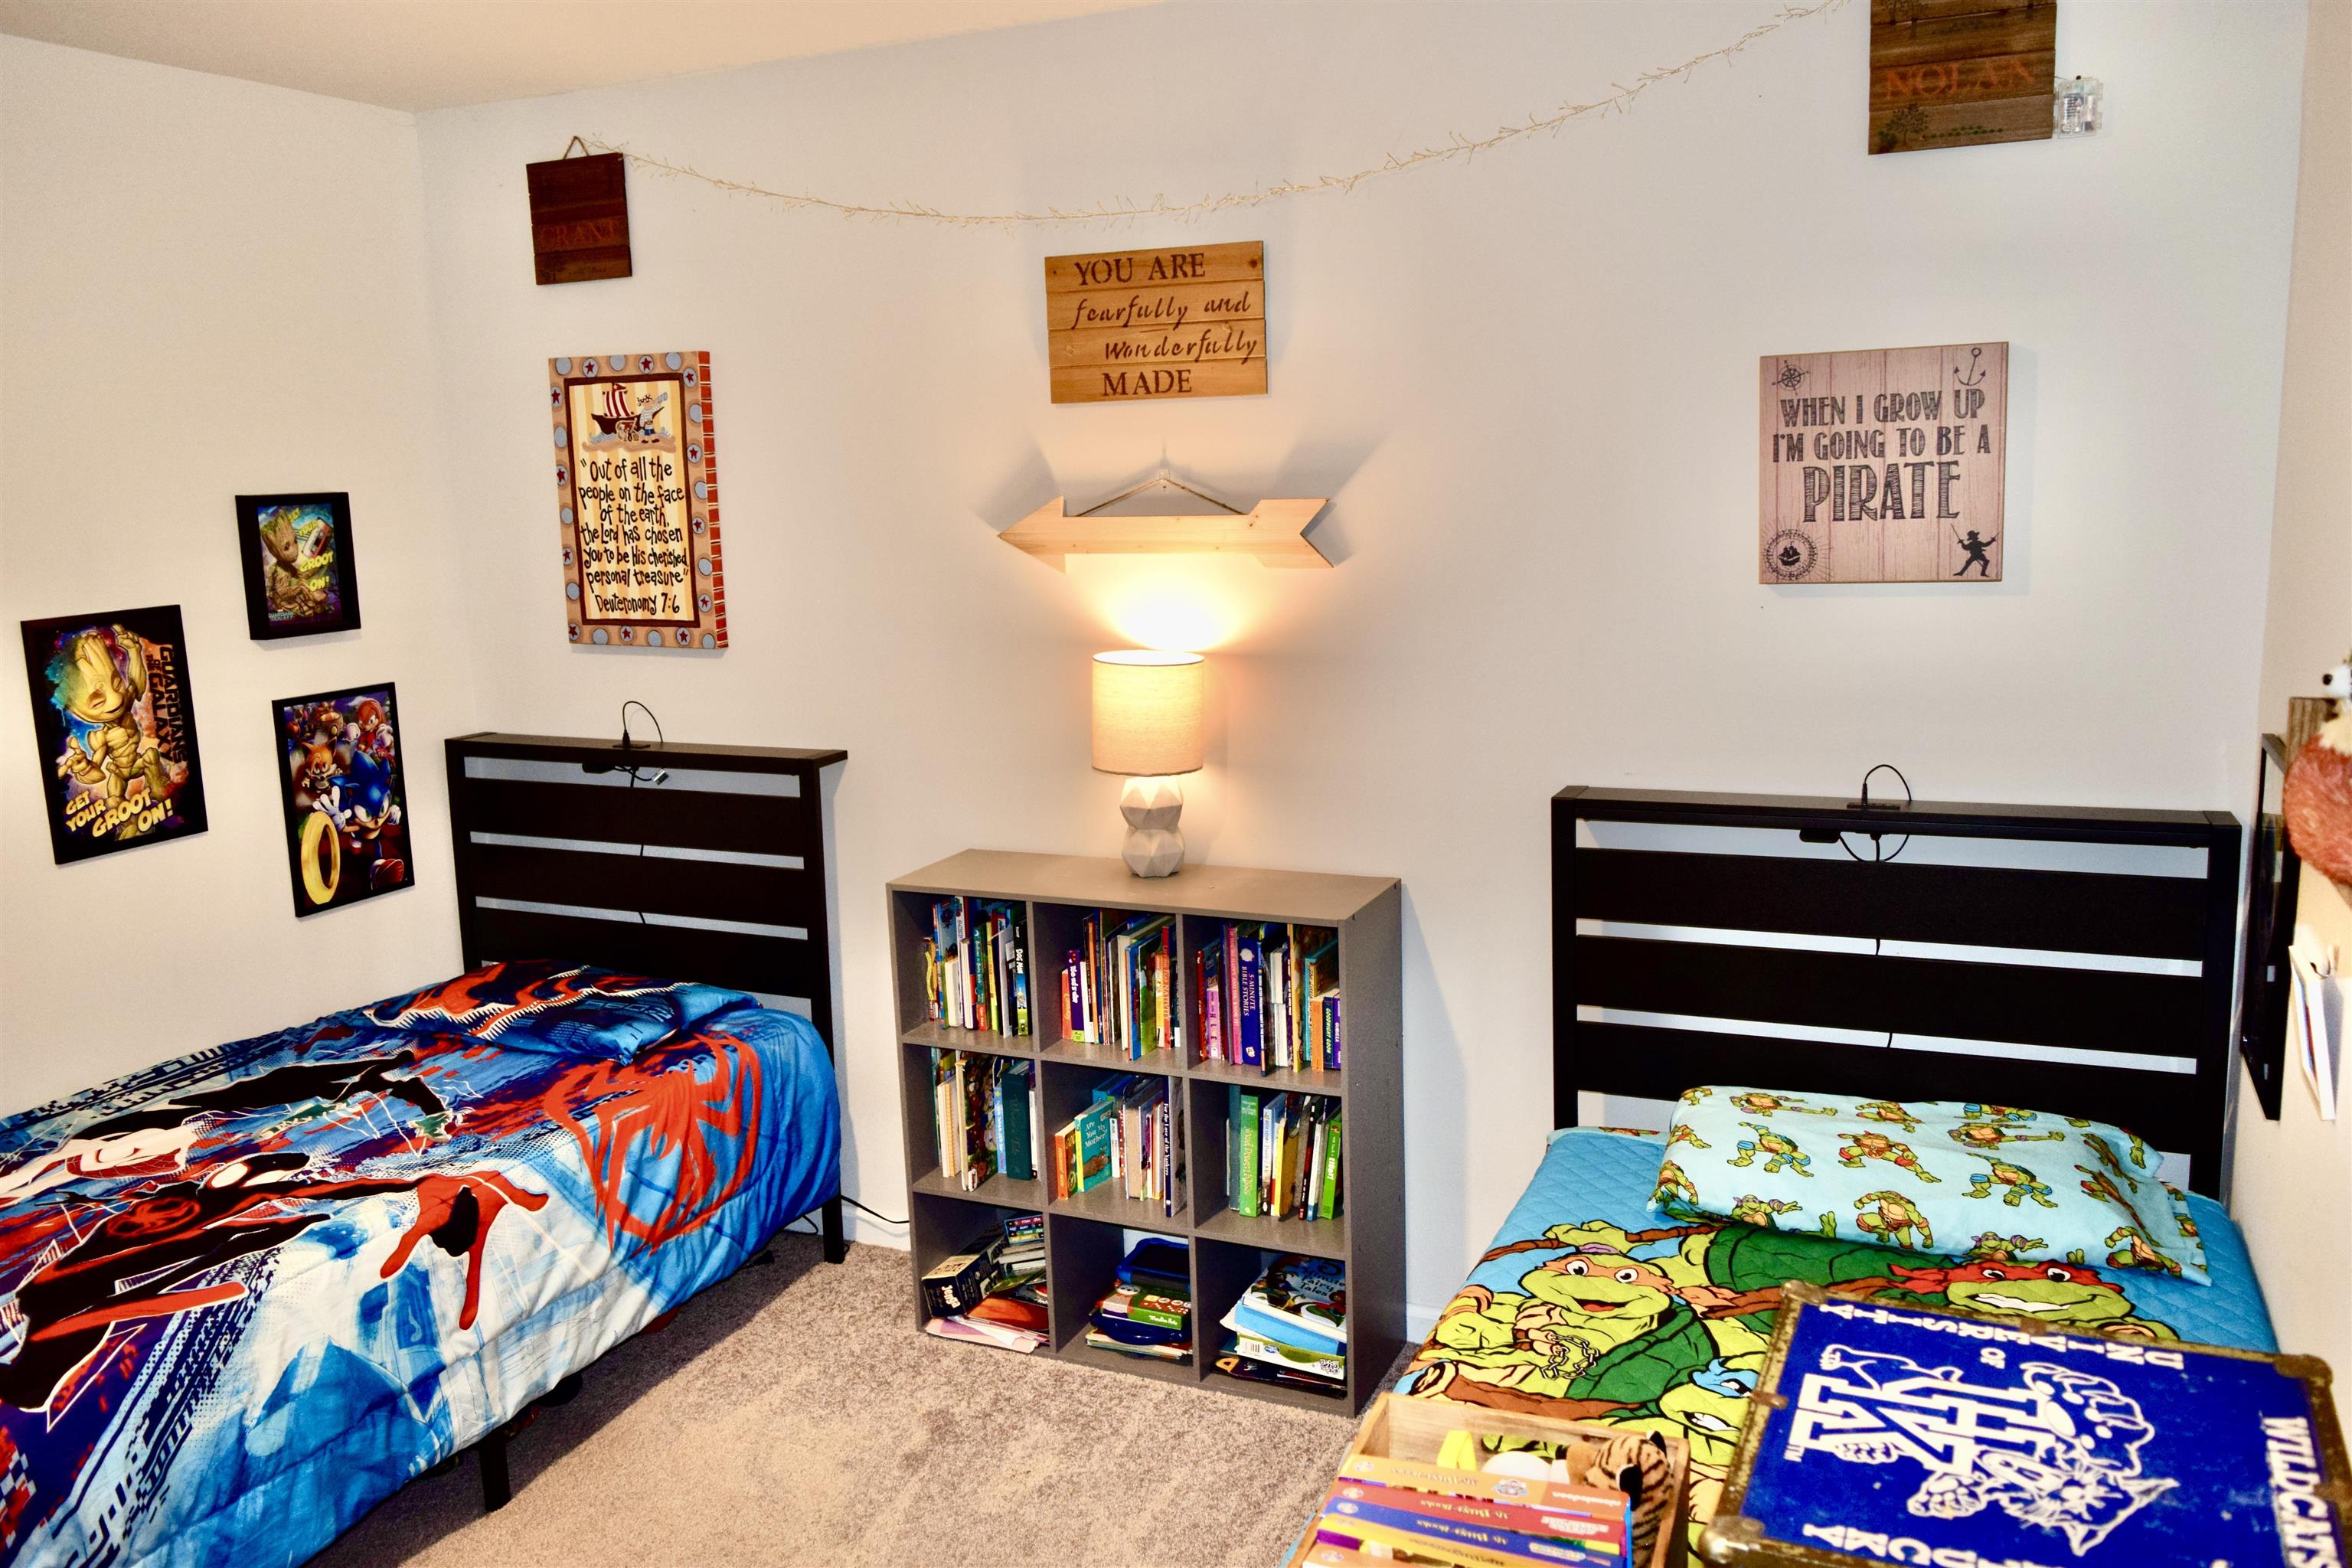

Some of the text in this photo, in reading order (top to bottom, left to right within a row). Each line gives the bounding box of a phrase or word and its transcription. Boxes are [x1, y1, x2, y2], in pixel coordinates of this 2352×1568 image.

[1884, 60, 2036, 100] NOLAN
[1073, 253, 1206, 286] YOU ARE
[1070, 291, 1251, 332] fearfully and
[1101, 369, 1192, 397] MADE
[1780, 388, 1985, 427] WHEN I GROW UP
[1772, 424, 1991, 462] I'M GOING TO BE A
[615, 458, 627, 482] of
[631, 456, 647, 482] all
[649, 456, 672, 482] the
[578, 484, 684, 511] people on the face
[1802, 460, 1961, 523] PIRATE
[599, 505, 612, 526] of
[617, 504, 638, 526] the
[580, 522, 683, 547] the Lord has chosen
[299, 551, 334, 572] GROOT
[583, 549, 603, 569] you
[603, 546, 616, 564] to
[616, 545, 630, 565] be
[632, 546, 646, 567] His
[586, 567, 631, 593] personal
[595, 593, 680, 615] Deuteronomy 7:6
[160, 644, 188, 764] GUARDIANS
[149, 673, 174, 763] GALAXY
[66, 789, 91, 815] GET
[66, 798, 106, 832] YOUR
[92, 788, 152, 838] GROOT
[136, 798, 174, 832] ON!
[1015, 949, 1024, 962] DOG
[942, 1285, 960, 1308] Jenga
[1300, 1282, 1328, 1296] Tales
[1302, 1276, 1334, 1292] Fairy
[1818, 1303, 2184, 1370] UNIVERSITY
[1979, 1348, 2005, 1369] OF
[2261, 1416, 2343, 1568] WILDCATS
